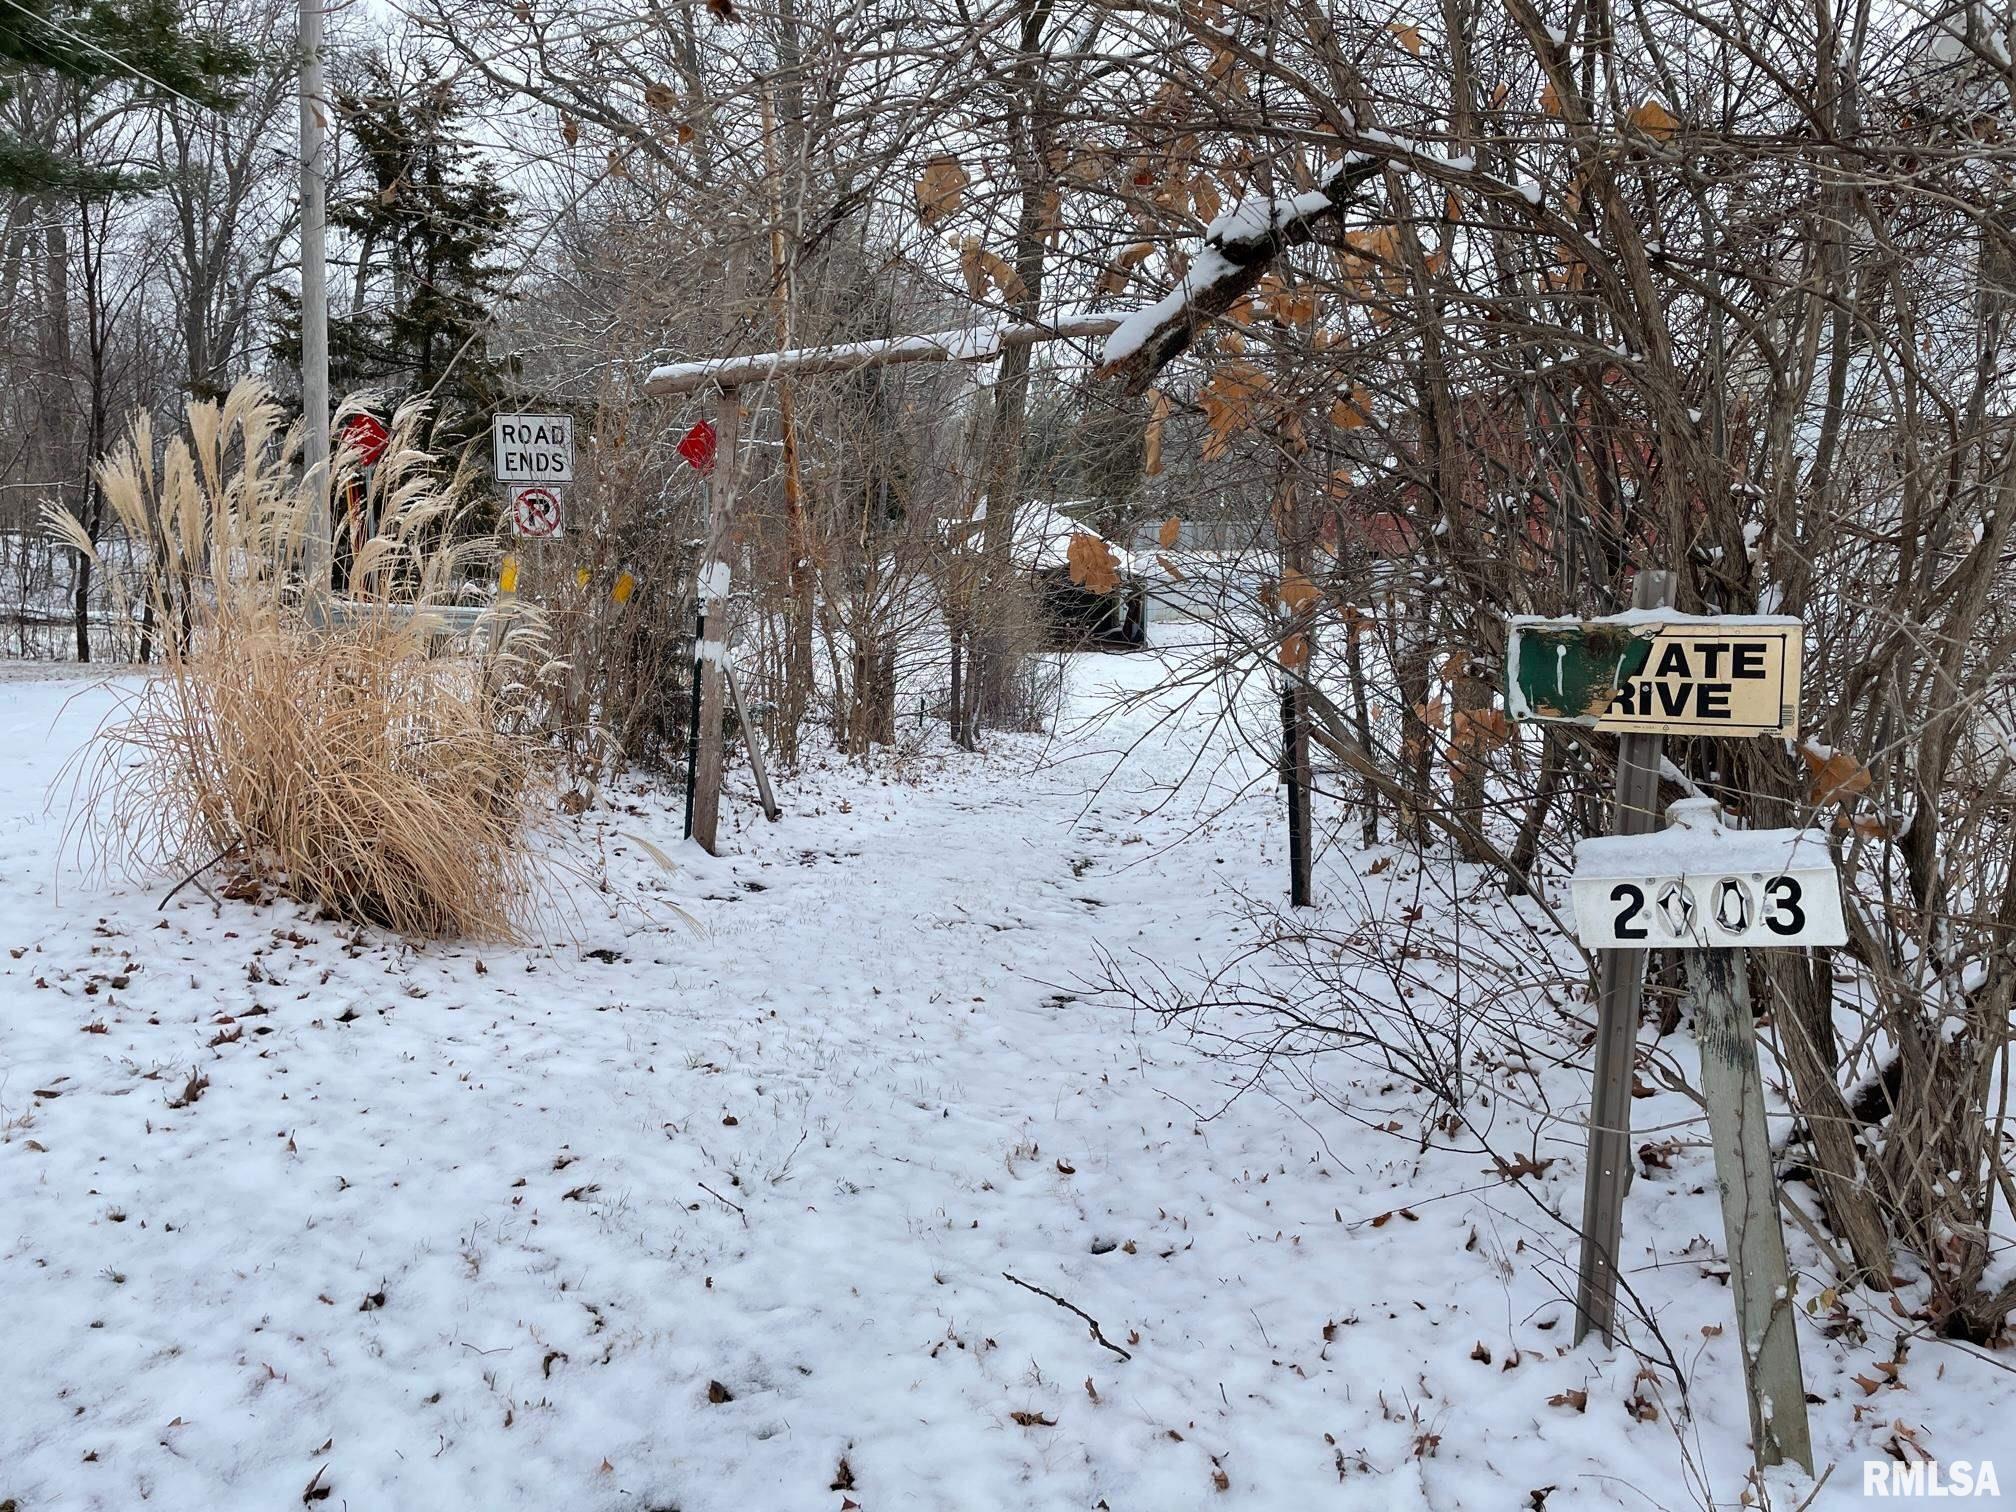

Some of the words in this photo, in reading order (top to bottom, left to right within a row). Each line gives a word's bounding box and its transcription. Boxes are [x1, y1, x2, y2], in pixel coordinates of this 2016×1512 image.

[502, 424, 565, 445] ROAD
[505, 452, 564, 472] ENDS
[1610, 876, 1806, 938] 2003
